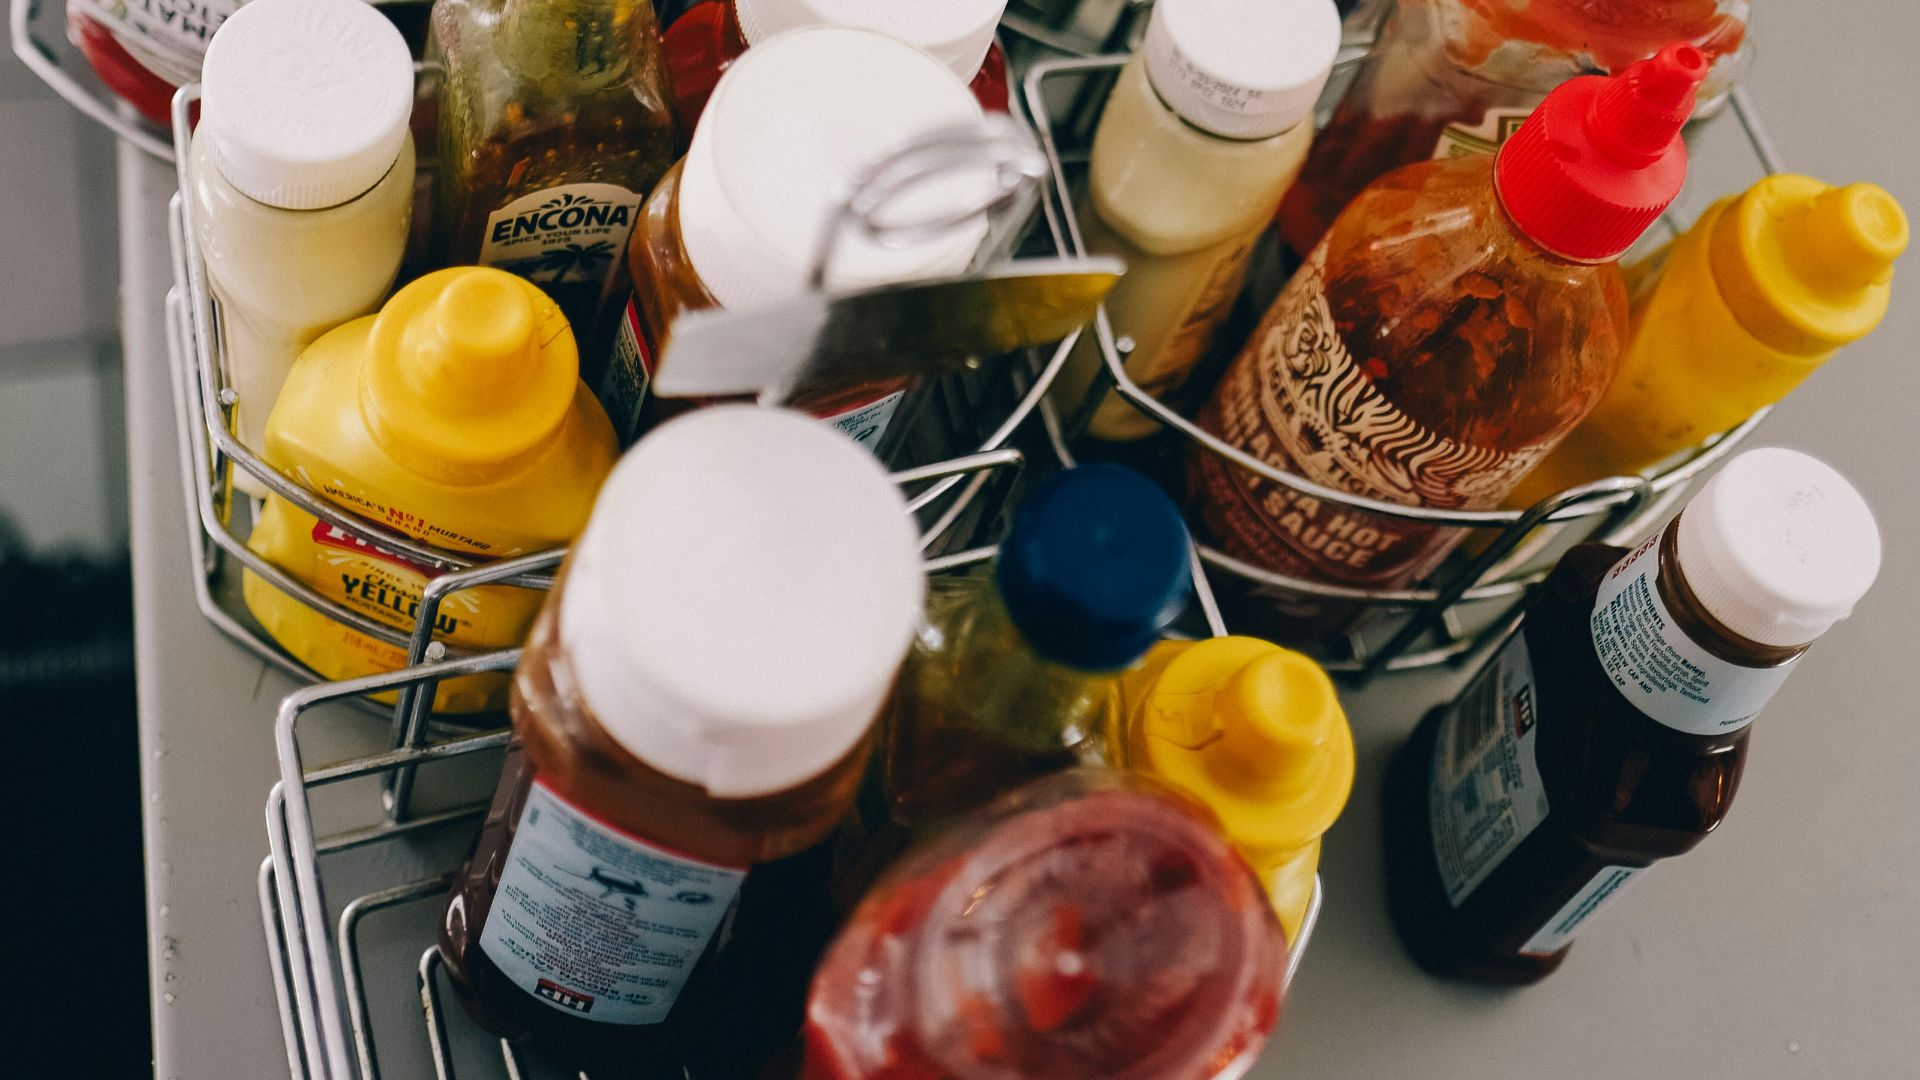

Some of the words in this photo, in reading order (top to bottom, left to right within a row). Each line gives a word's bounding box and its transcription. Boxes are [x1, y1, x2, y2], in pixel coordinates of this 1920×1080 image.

[491, 205, 628, 243] ENCONA
[323, 484, 385, 514] AMERICA'S
[428, 525, 491, 550] MUSTARD
[386, 516, 430, 537] BRAND
[1263, 491, 1377, 568] SAUCE
[1326, 514, 1401, 552] HOT
[1640, 572, 1665, 630] INGREDIENTS
[1610, 600, 1630, 652] Allergens:
[1650, 623, 1666, 646] Vinegar
[1665, 645, 1681, 661] (from
[1610, 636, 1629, 667] UNSCREW
[1628, 668, 1639, 680] CAP
[1638, 681, 1653, 694] AND
[1614, 674, 1626, 686] CAP
[1650, 652, 1674, 676] Modified
[1680, 687, 1710, 704] Tamarind
[541, 987, 586, 1011] HP
